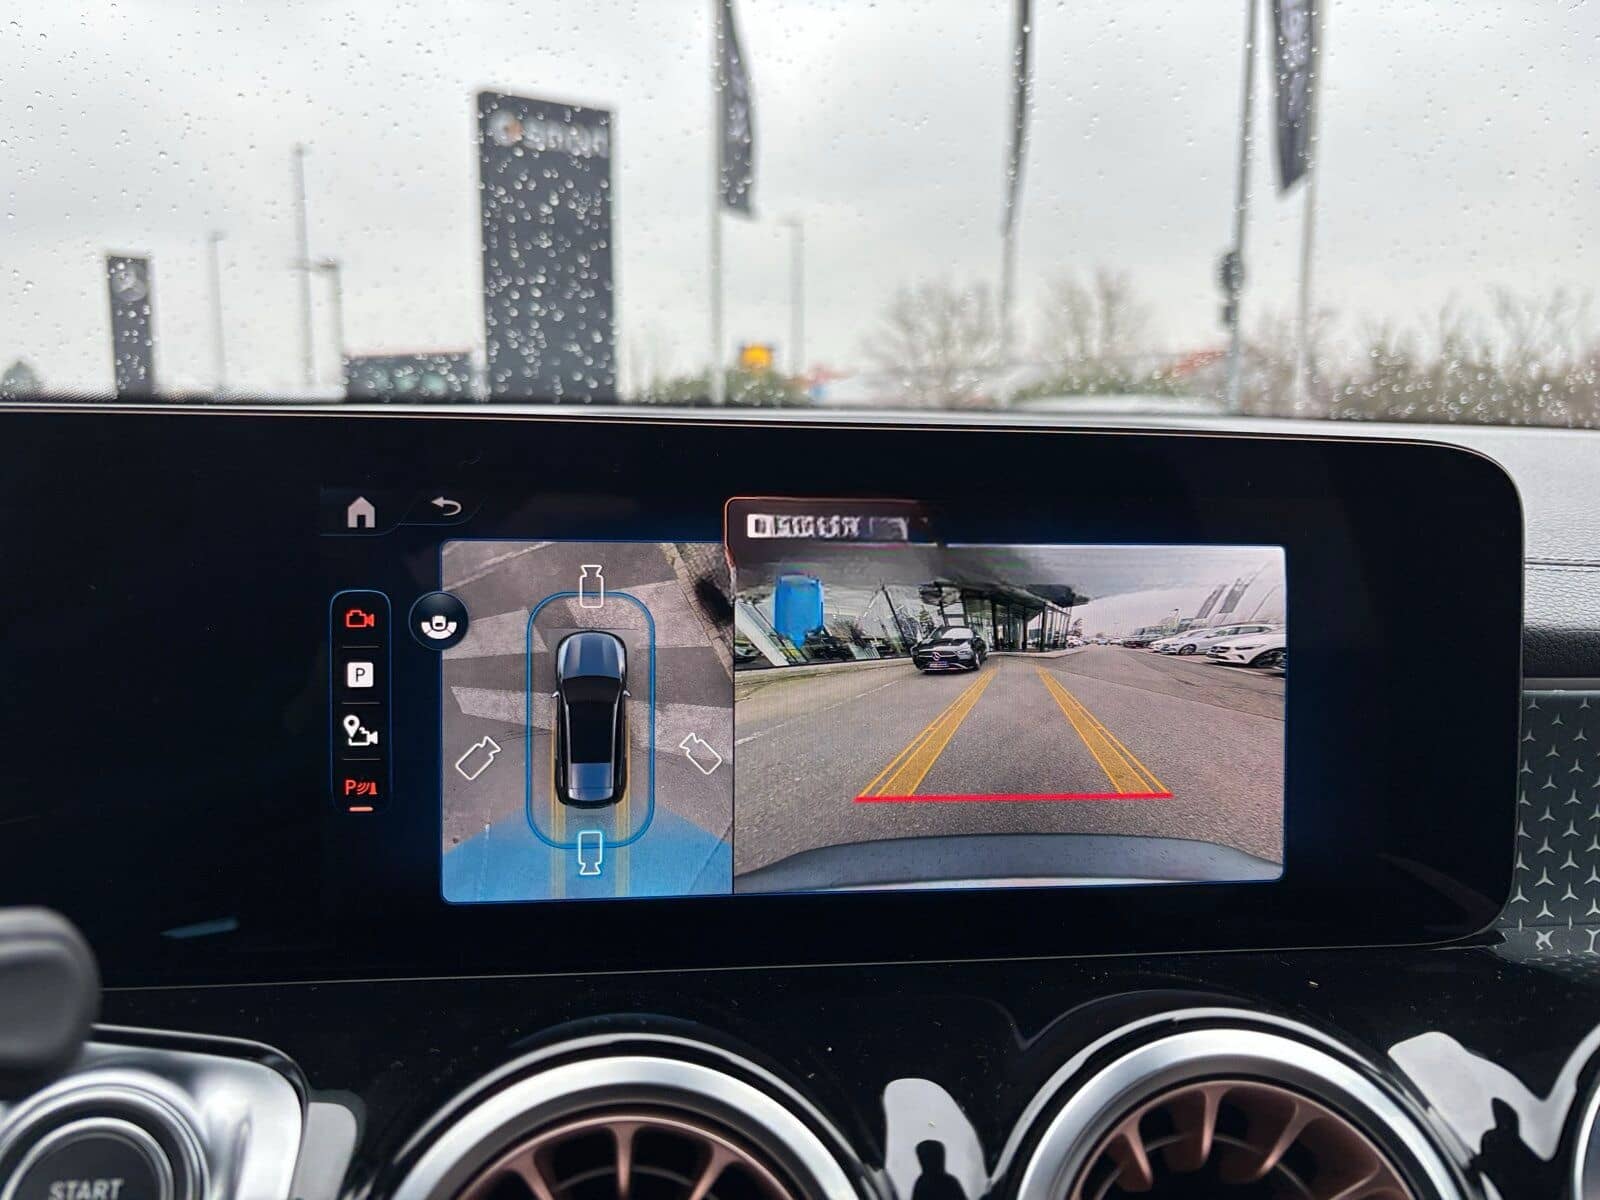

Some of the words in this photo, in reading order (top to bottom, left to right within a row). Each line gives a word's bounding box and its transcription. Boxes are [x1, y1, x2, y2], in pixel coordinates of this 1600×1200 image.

[355, 668, 366, 682] P
[345, 780, 357, 795] P
[48, 1178, 124, 1200] START
